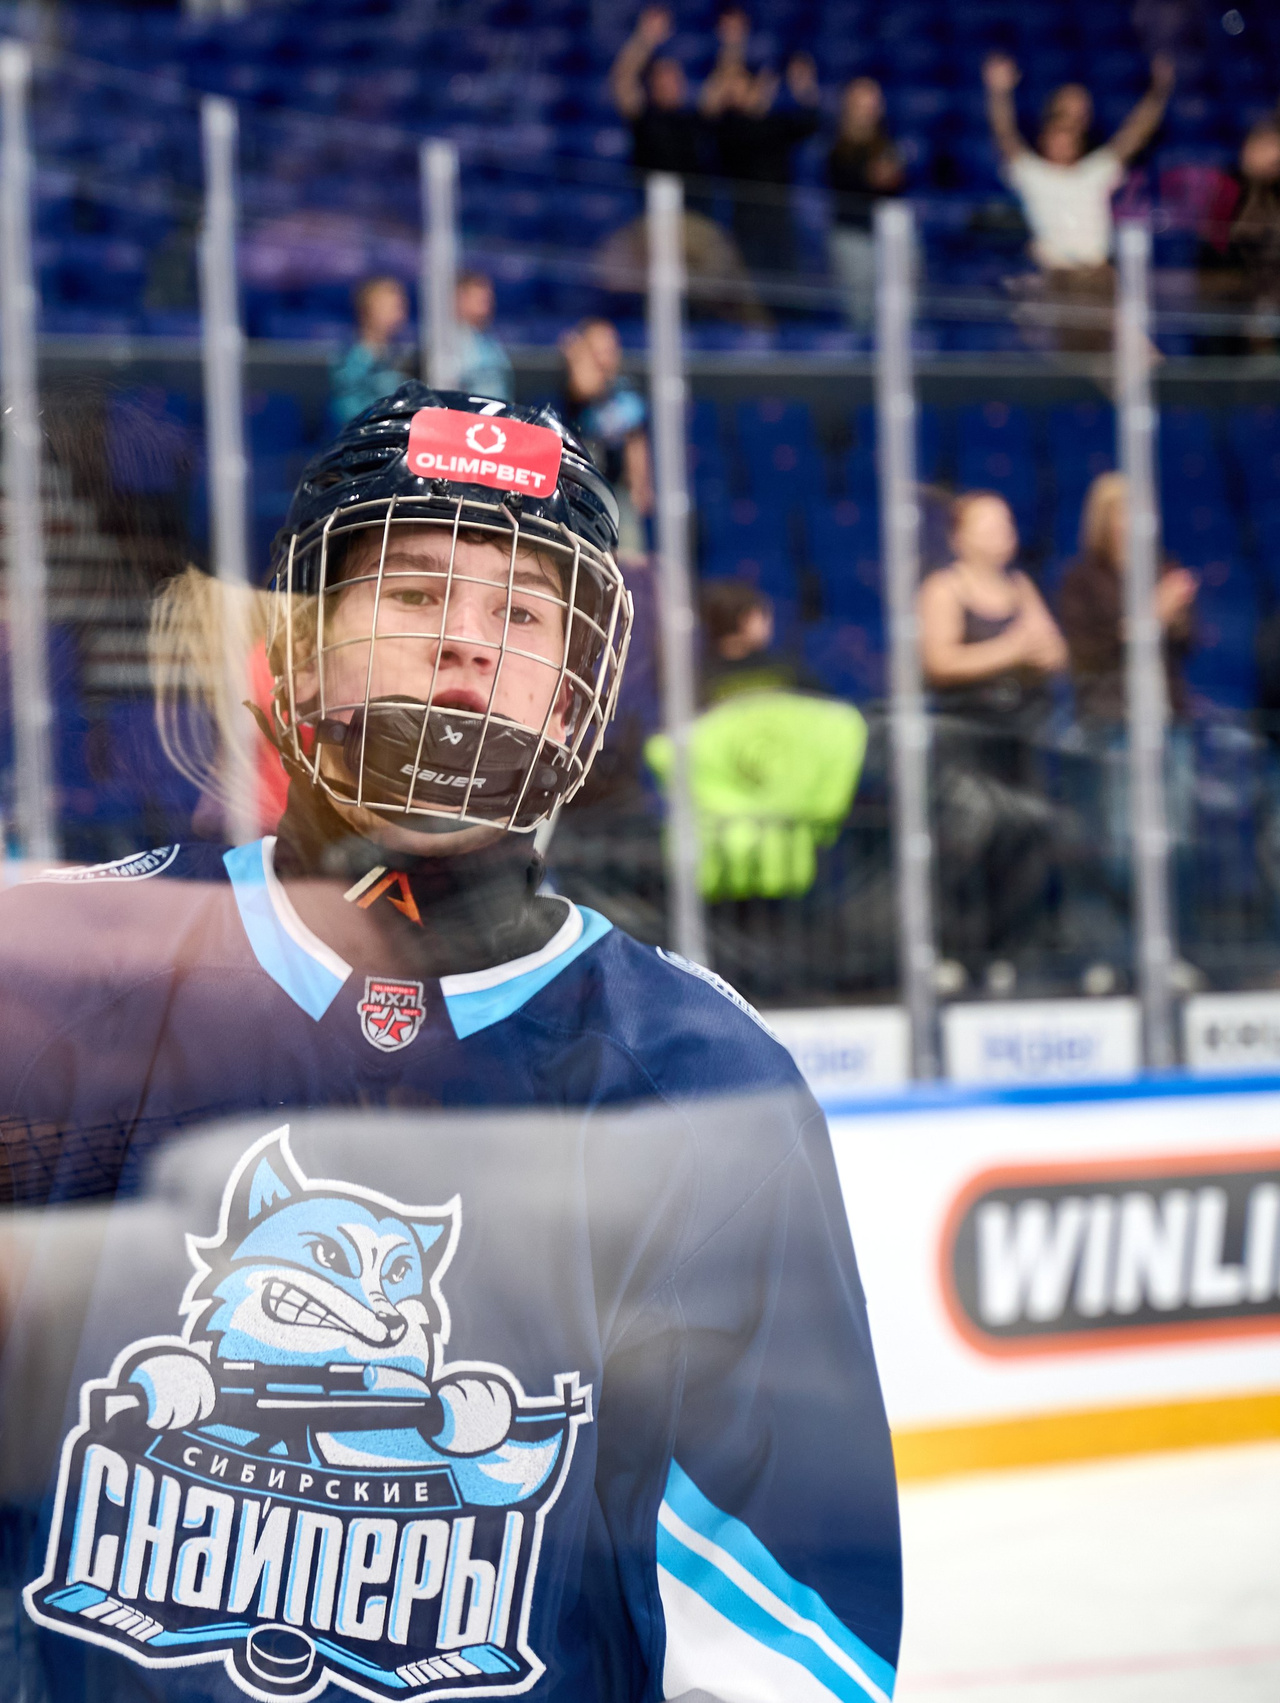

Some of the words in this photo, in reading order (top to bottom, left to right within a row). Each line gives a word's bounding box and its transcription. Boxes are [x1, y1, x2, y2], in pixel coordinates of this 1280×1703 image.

[416, 452, 546, 488] OLIMPBET
[400, 763, 487, 788] BAUER
[370, 990, 416, 1008] МХЛ
[182, 1446, 430, 1503] СИБИРСКИЕ
